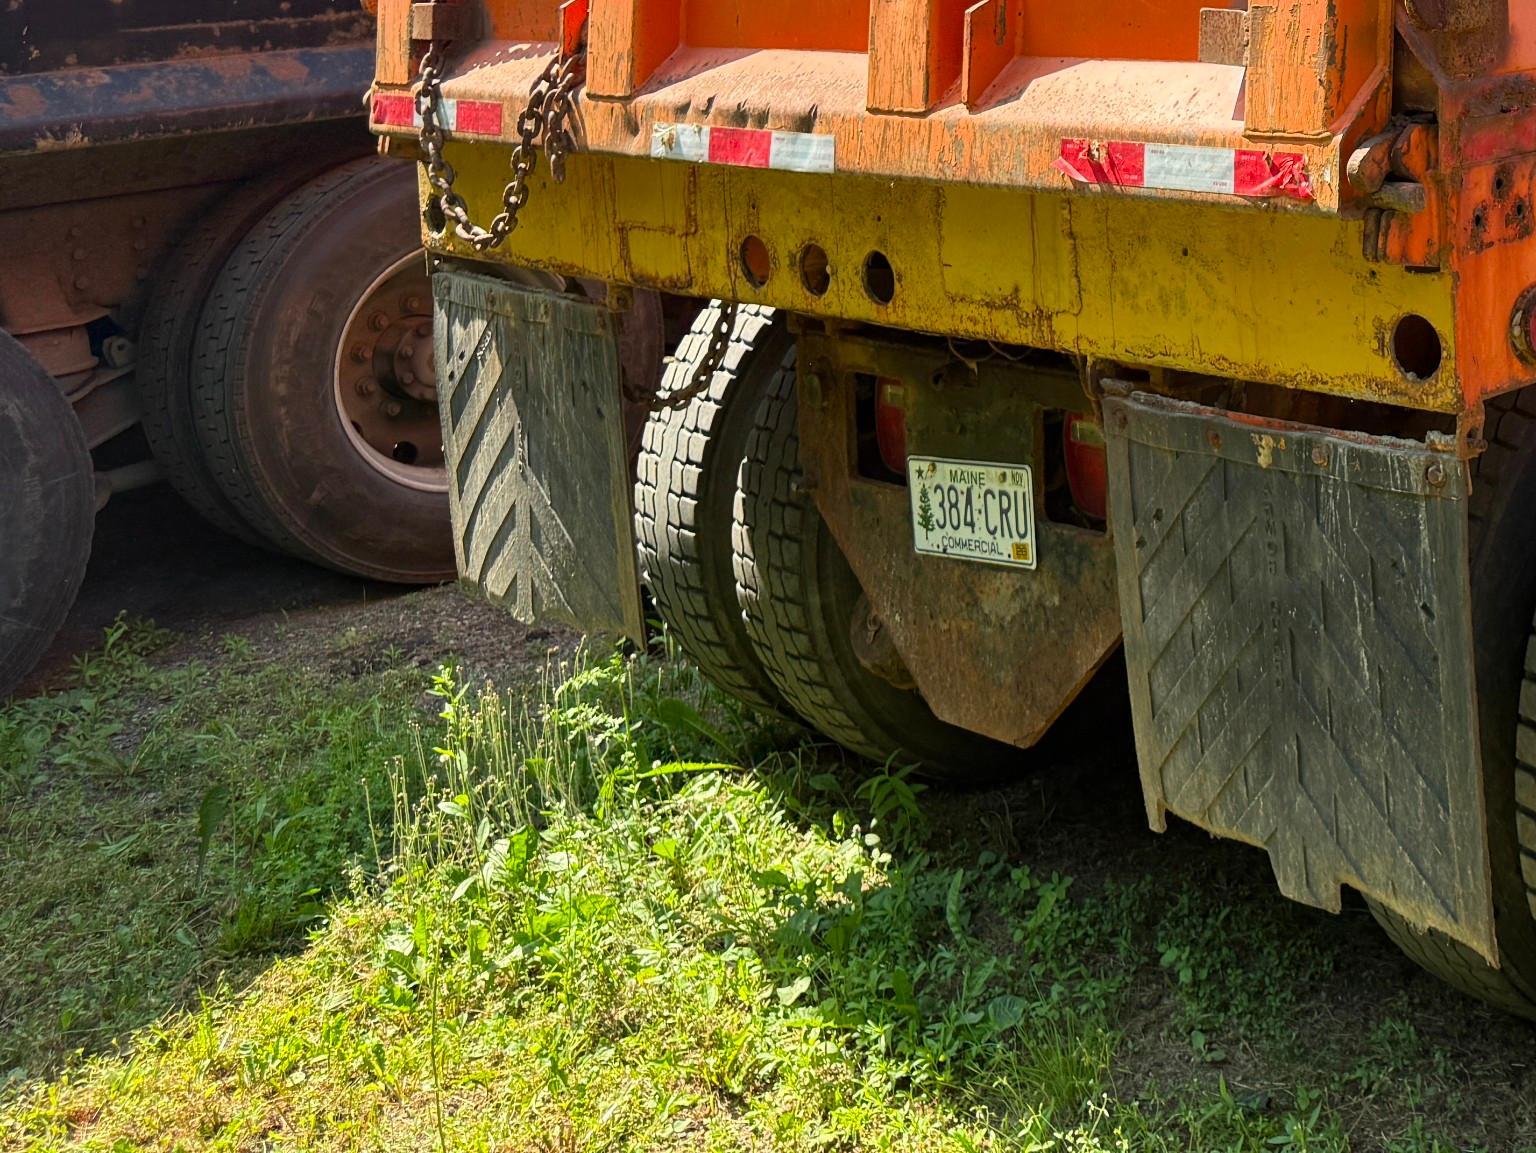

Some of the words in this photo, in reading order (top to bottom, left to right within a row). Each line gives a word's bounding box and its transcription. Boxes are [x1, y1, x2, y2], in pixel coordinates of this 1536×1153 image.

[949, 469, 986, 486] MAINE
[933, 482, 976, 534] 384
[983, 488, 1028, 540] CRU
[941, 535, 1004, 556] COMMERCIAL
